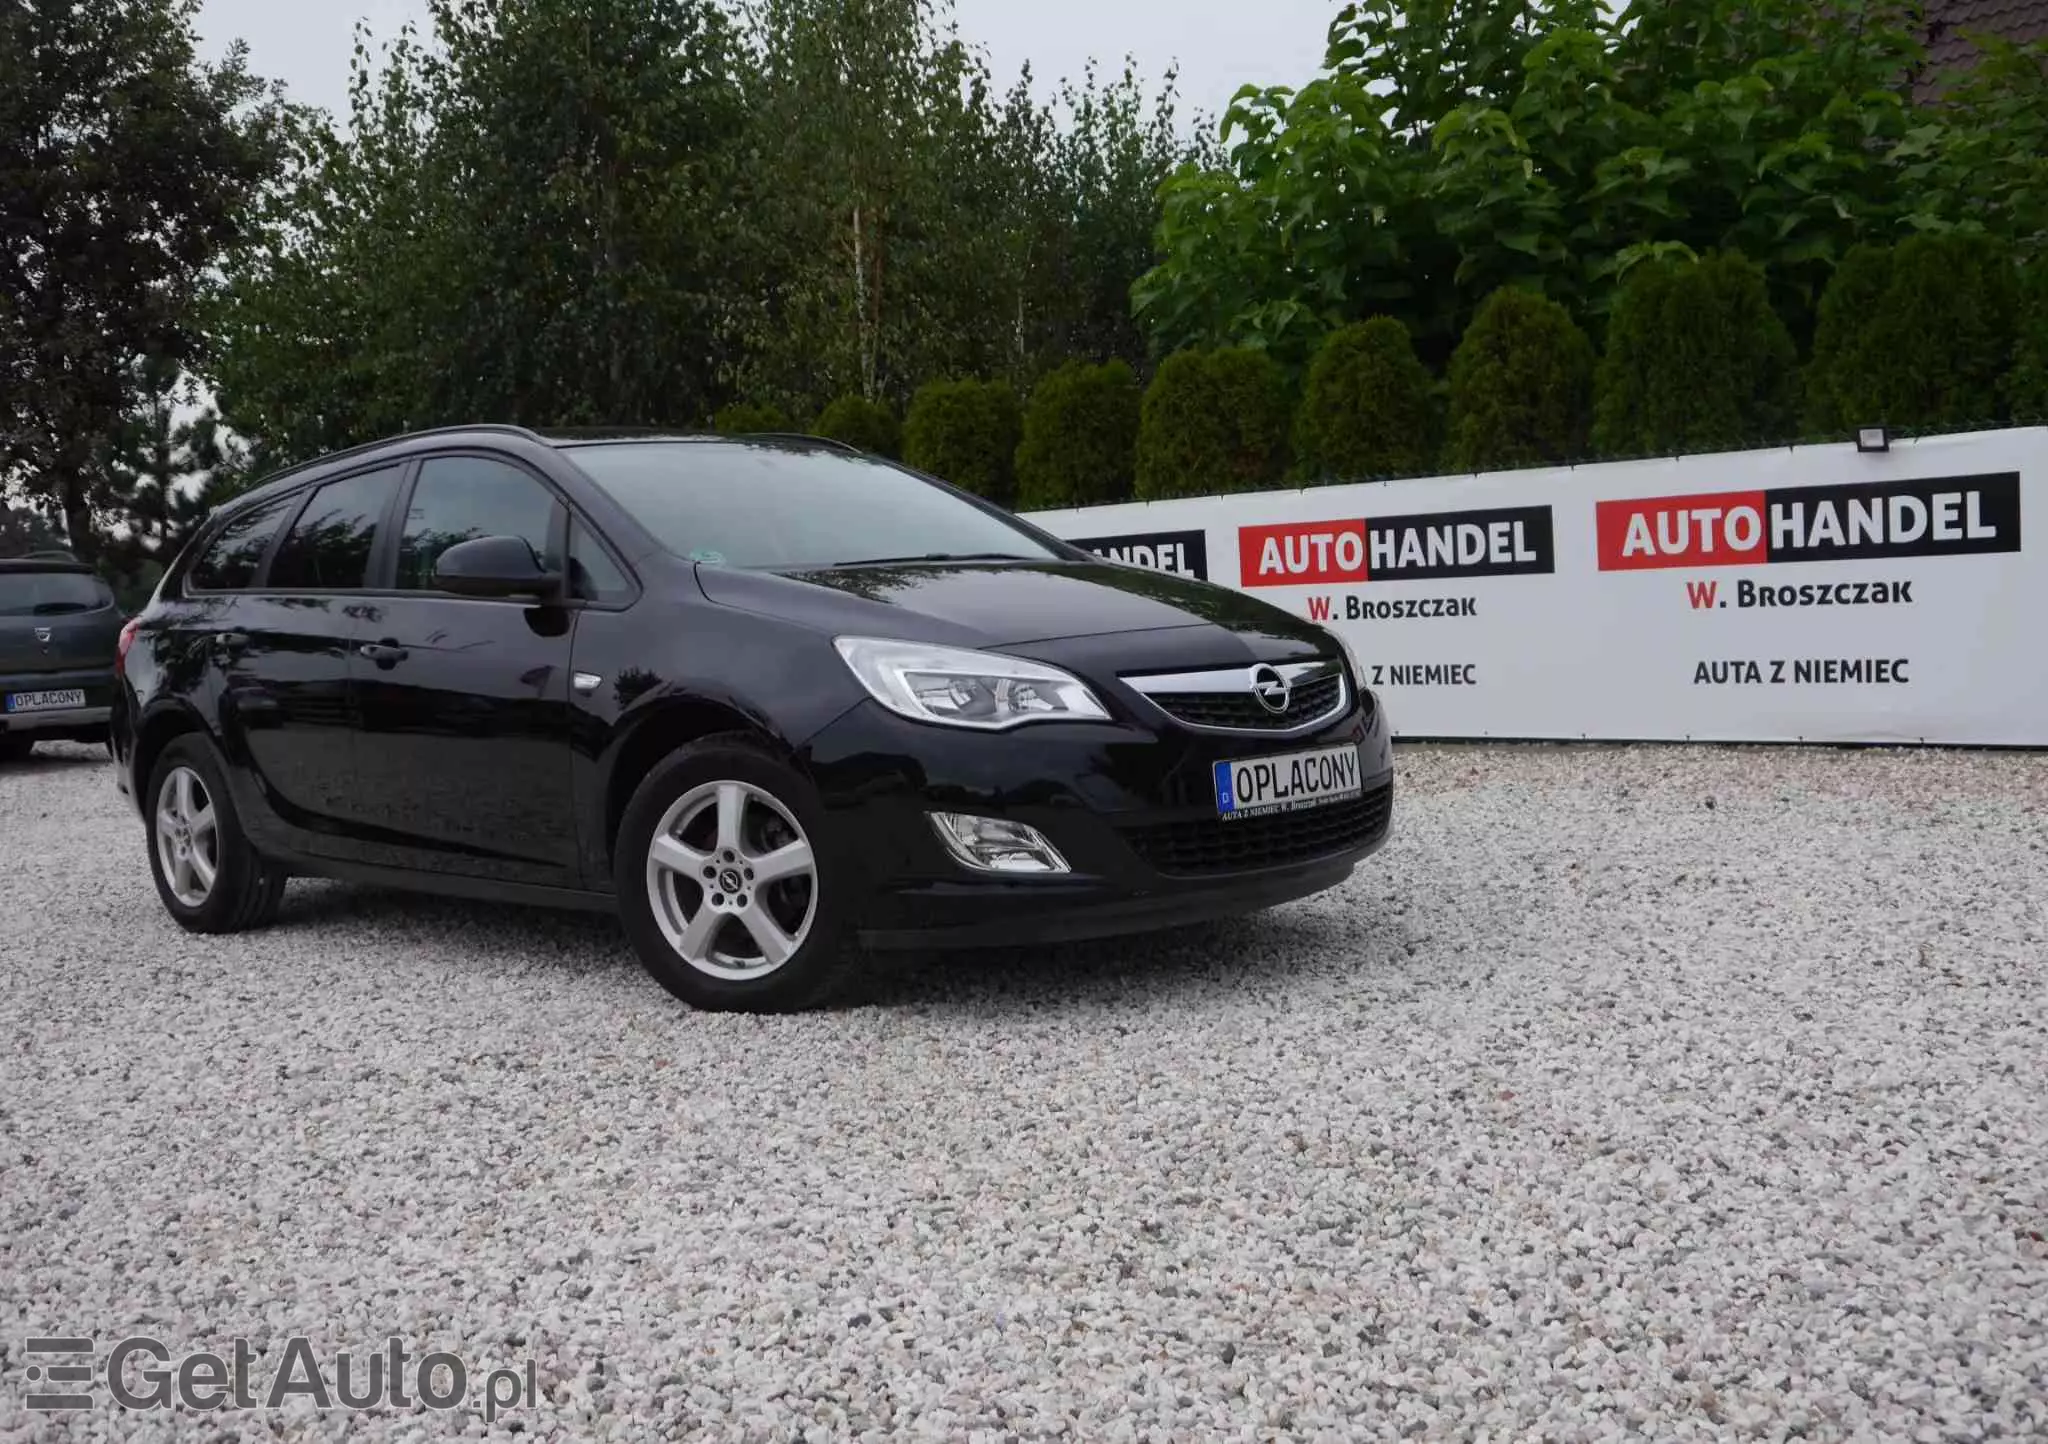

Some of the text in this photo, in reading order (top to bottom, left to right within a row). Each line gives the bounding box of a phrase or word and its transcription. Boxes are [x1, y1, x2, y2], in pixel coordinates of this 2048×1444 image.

[1622, 491, 1996, 558] AUTOHANDEL
[1259, 521, 1536, 575] AUTOHANDEL
[1686, 580, 1727, 609] W.
[1308, 597, 1338, 620] W.
[1372, 664, 1476, 685] Z NIEMIEC
[1694, 658, 1910, 684] AUTA Z NIEMIEC
[15, 691, 82, 706] OPLACONY
[1236, 751, 1355, 802] OPLACONY
